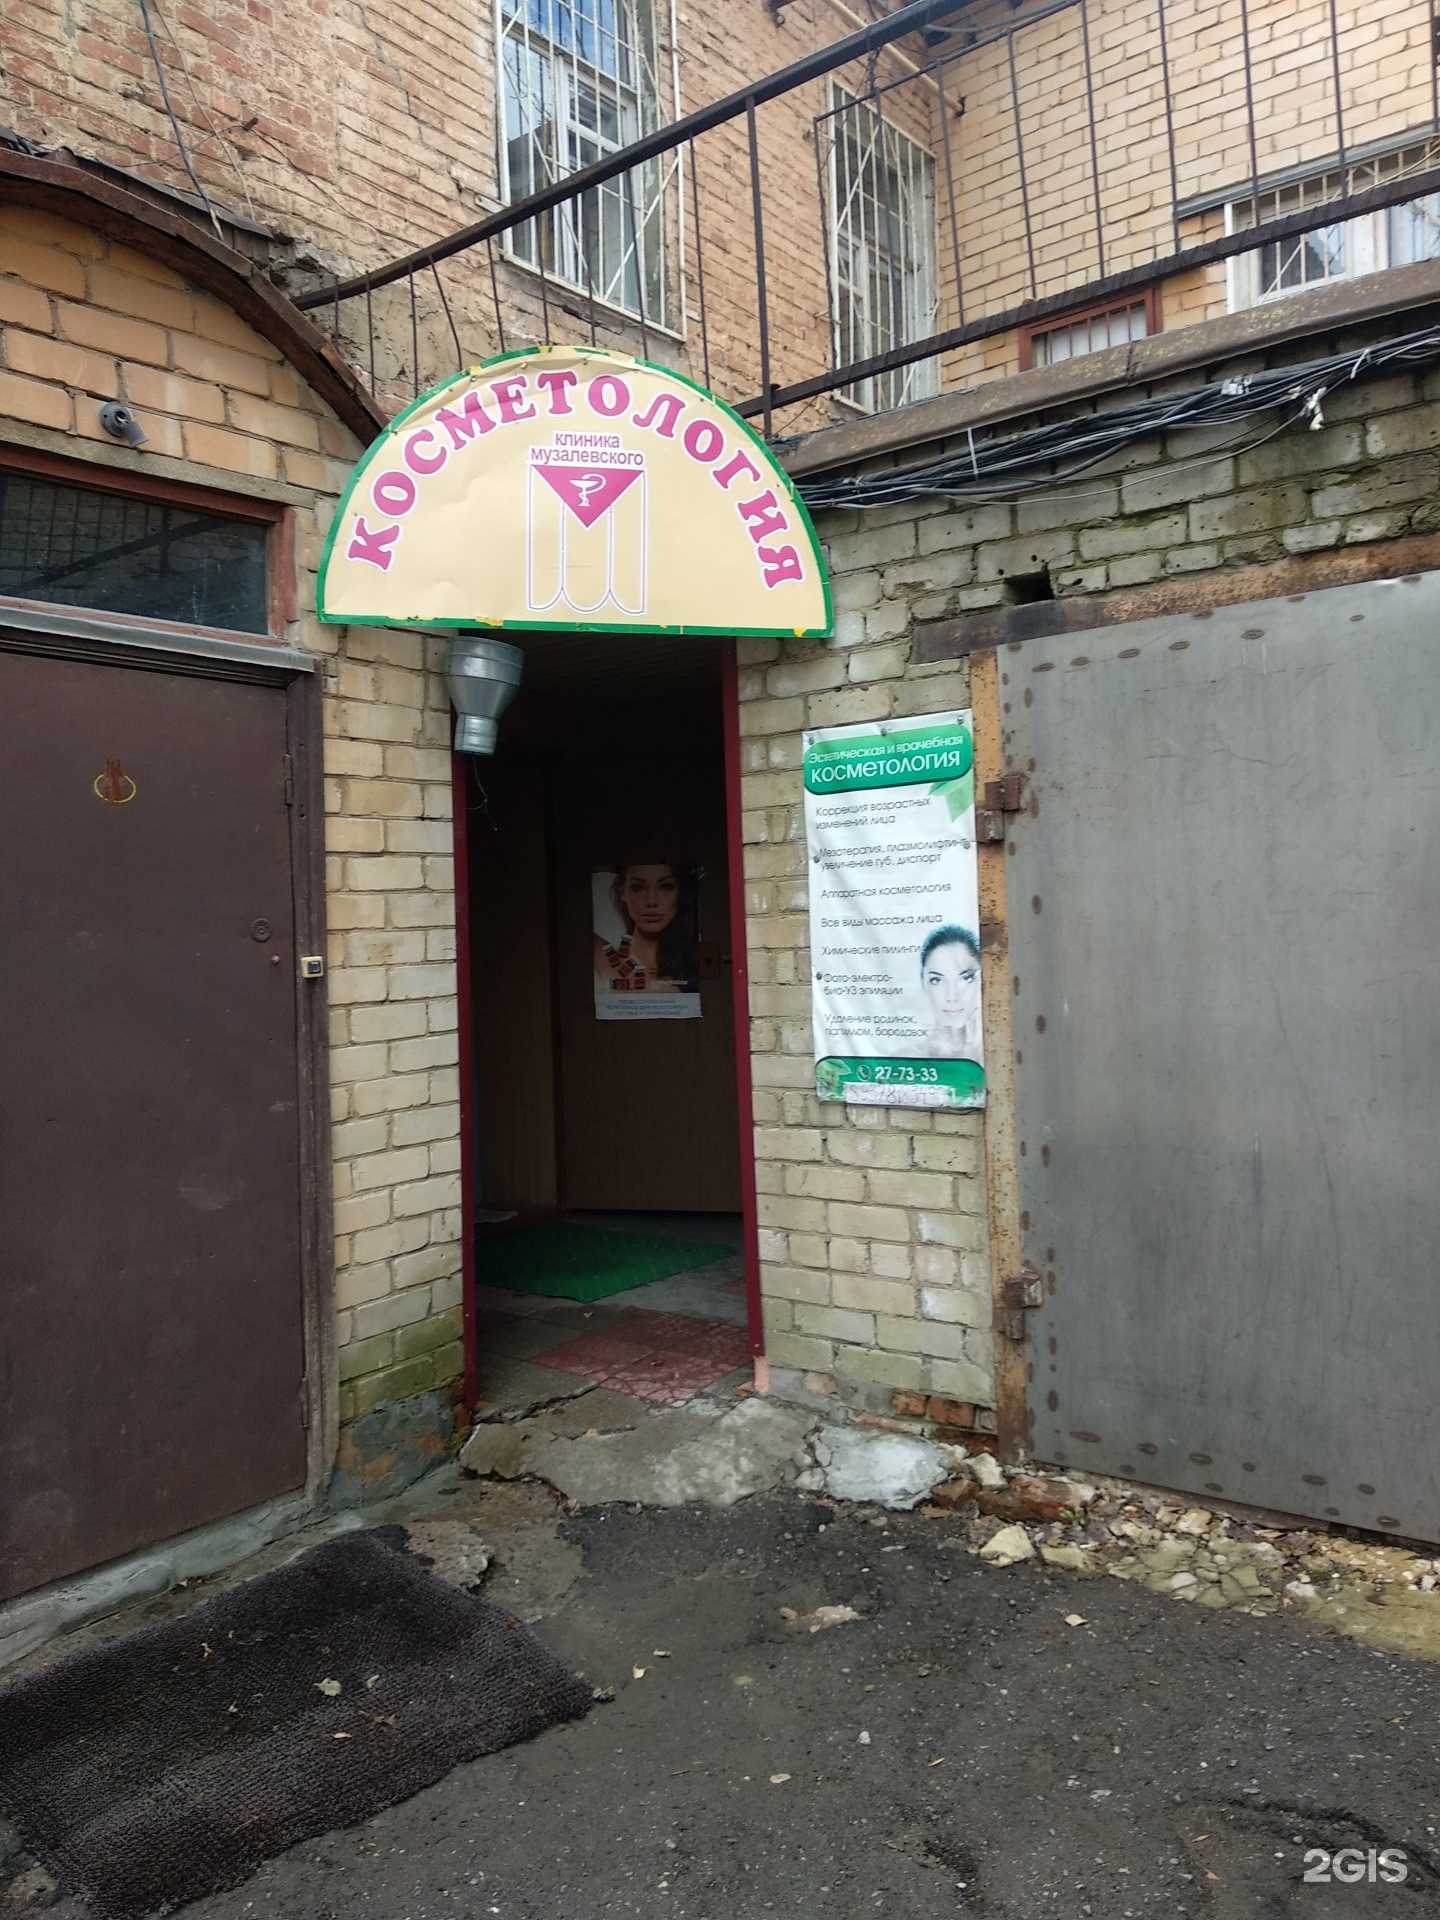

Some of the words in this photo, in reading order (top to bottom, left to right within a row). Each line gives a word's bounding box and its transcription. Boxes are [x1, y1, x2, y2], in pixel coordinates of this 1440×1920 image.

[555, 433, 620, 448] клиника
[531, 447, 644, 466] музалевского
[349, 371, 803, 588] КОСМЕТОЛОГИЯ
[809, 746, 886, 763] Эстетическая
[896, 736, 964, 754] врачебная
[816, 803, 869, 817] Коррекция
[870, 798, 931, 812] возрастных
[870, 815, 896, 825] лица
[820, 887, 876, 899] Аппаратная
[879, 882, 952, 896] косметология
[820, 918, 840, 928] Все
[841, 917, 863, 928] виды
[864, 915, 914, 926] массажа
[916, 914, 943, 925] лица
[821, 945, 880, 956] Химические
[824, 1014, 873, 1025] Удаление
[874, 1066, 938, 1081] 27-73-33
